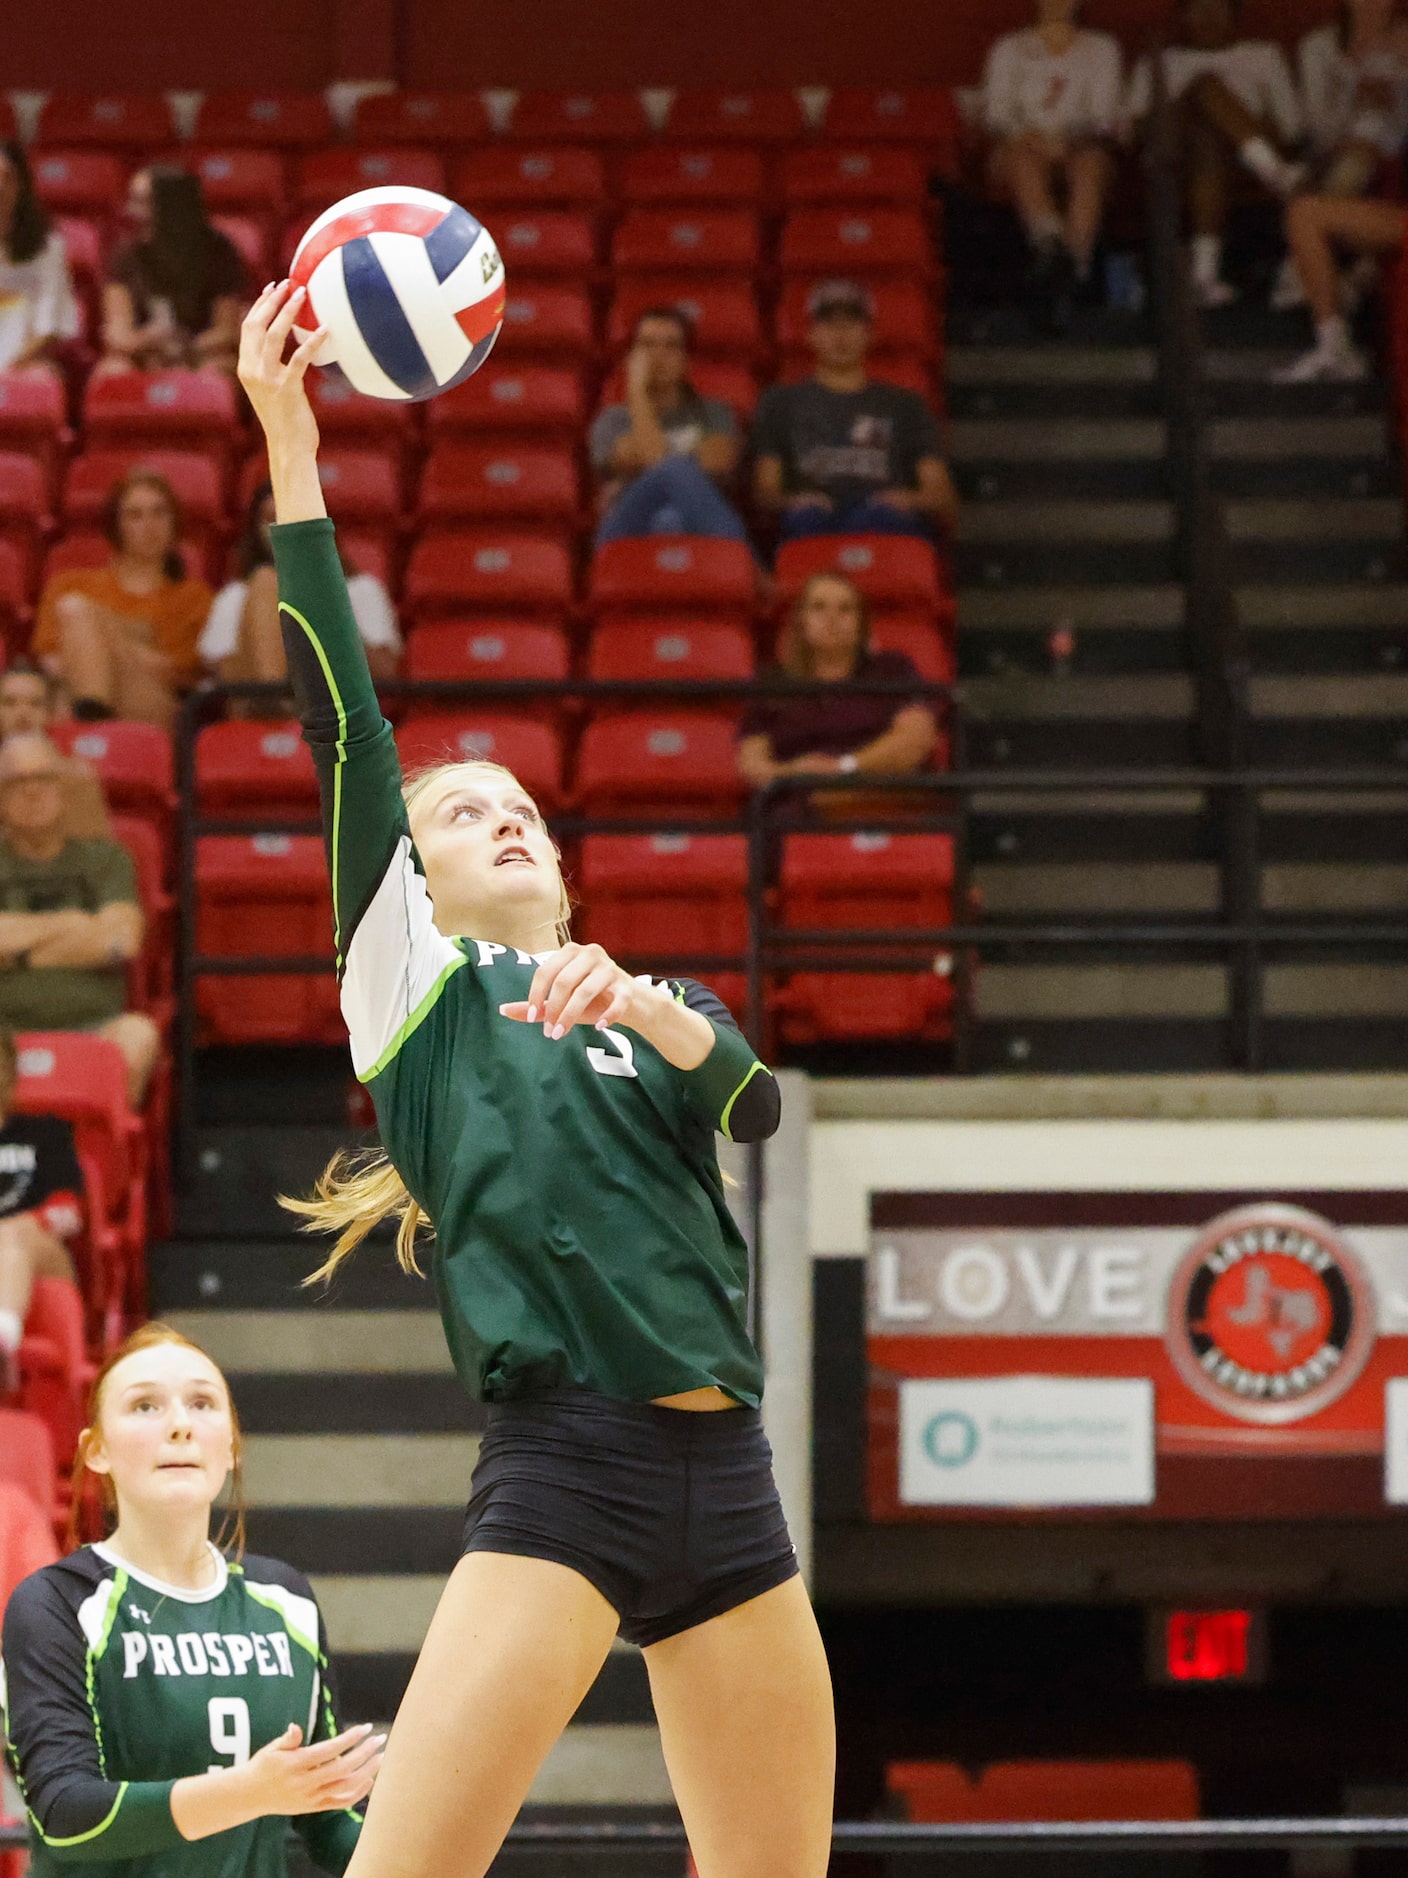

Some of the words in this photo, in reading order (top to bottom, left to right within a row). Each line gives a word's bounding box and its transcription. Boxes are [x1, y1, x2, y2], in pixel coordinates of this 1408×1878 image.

[877, 1244, 1143, 1319] LOVE
[120, 1631, 294, 1678] PROSPER
[207, 1697, 250, 1775] 9
